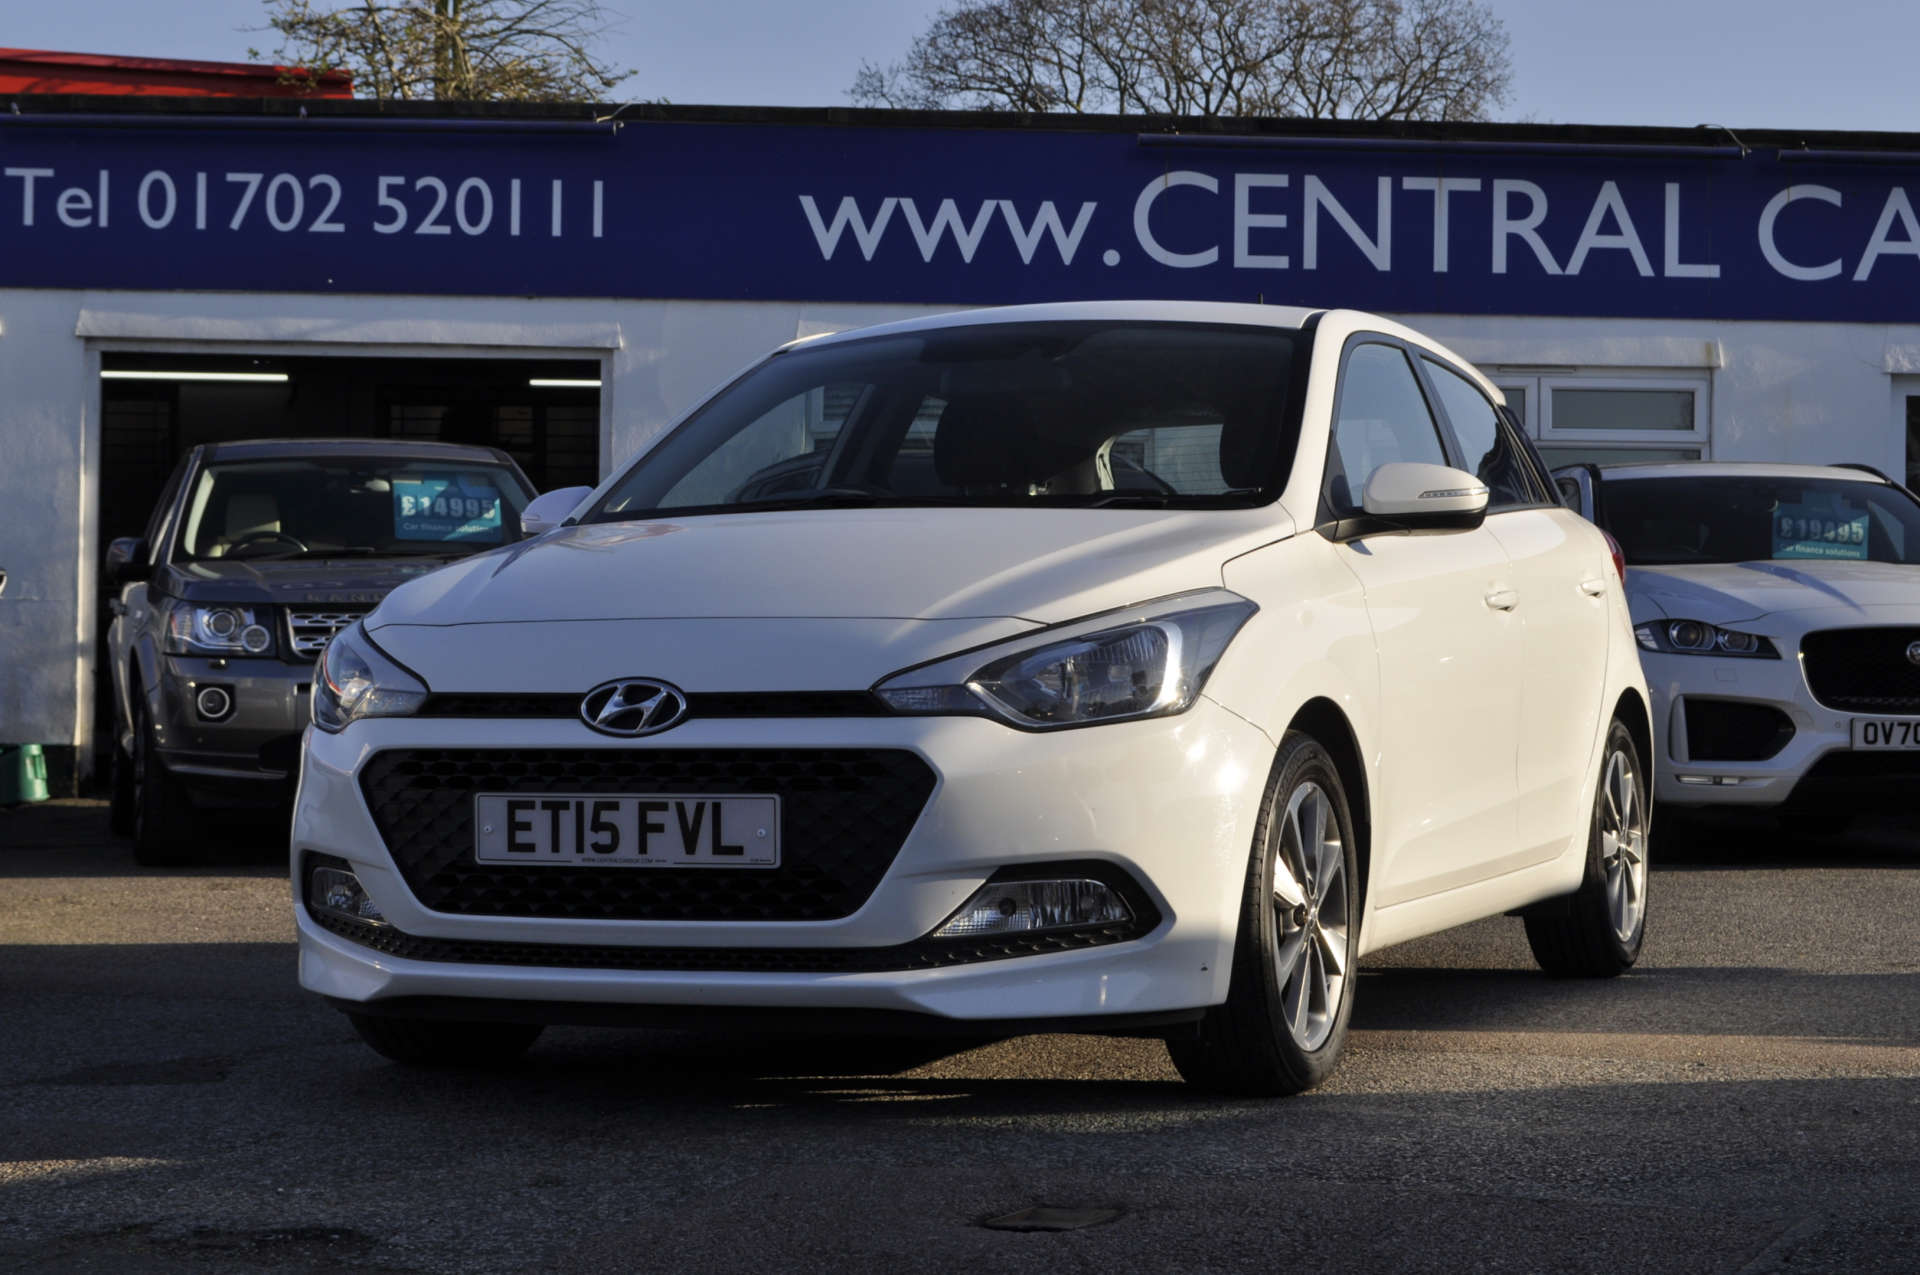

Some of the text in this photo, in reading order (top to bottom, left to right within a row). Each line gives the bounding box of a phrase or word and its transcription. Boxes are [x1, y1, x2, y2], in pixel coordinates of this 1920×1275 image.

[5, 168, 603, 237] Tel 01702 520111
[400, 496, 496, 519] £14995
[637, 800, 745, 857] FVL
